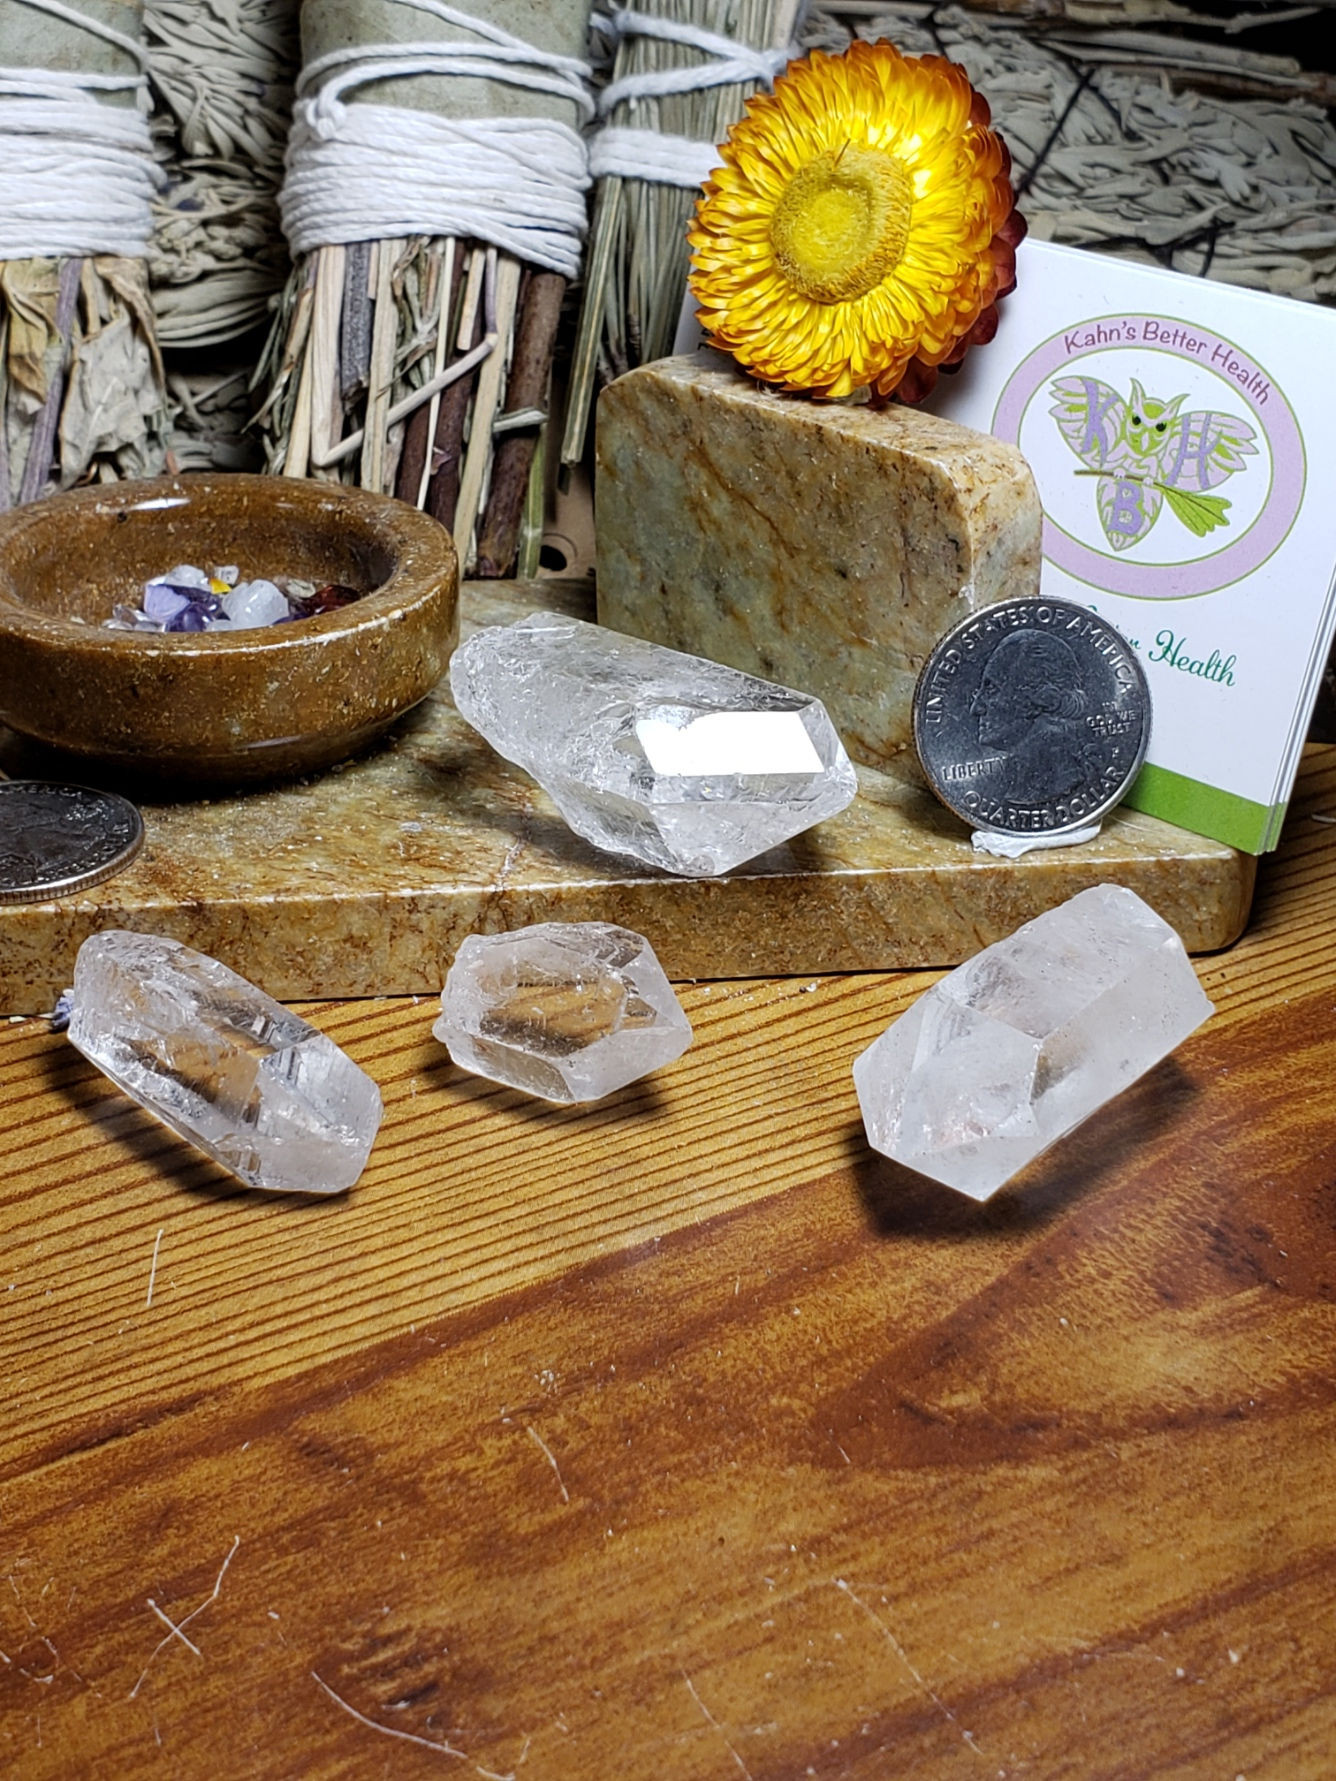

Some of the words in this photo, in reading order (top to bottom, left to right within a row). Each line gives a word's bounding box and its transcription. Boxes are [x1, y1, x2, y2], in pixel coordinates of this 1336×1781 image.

[1063, 322, 1136, 354] Kahn's
[1142, 321, 1207, 354] Better
[1211, 344, 1270, 405] Health
[926, 649, 963, 723] UNITED
[962, 607, 1033, 649] STATES
[1037, 606, 1065, 625] OF
[1066, 617, 1138, 694] AMERICA
[1148, 630, 1236, 687] Health
[942, 756, 1007, 781] LIBERTY
[964, 791, 1054, 829] QUARTER
[1055, 766, 1125, 822] DOLLAR
